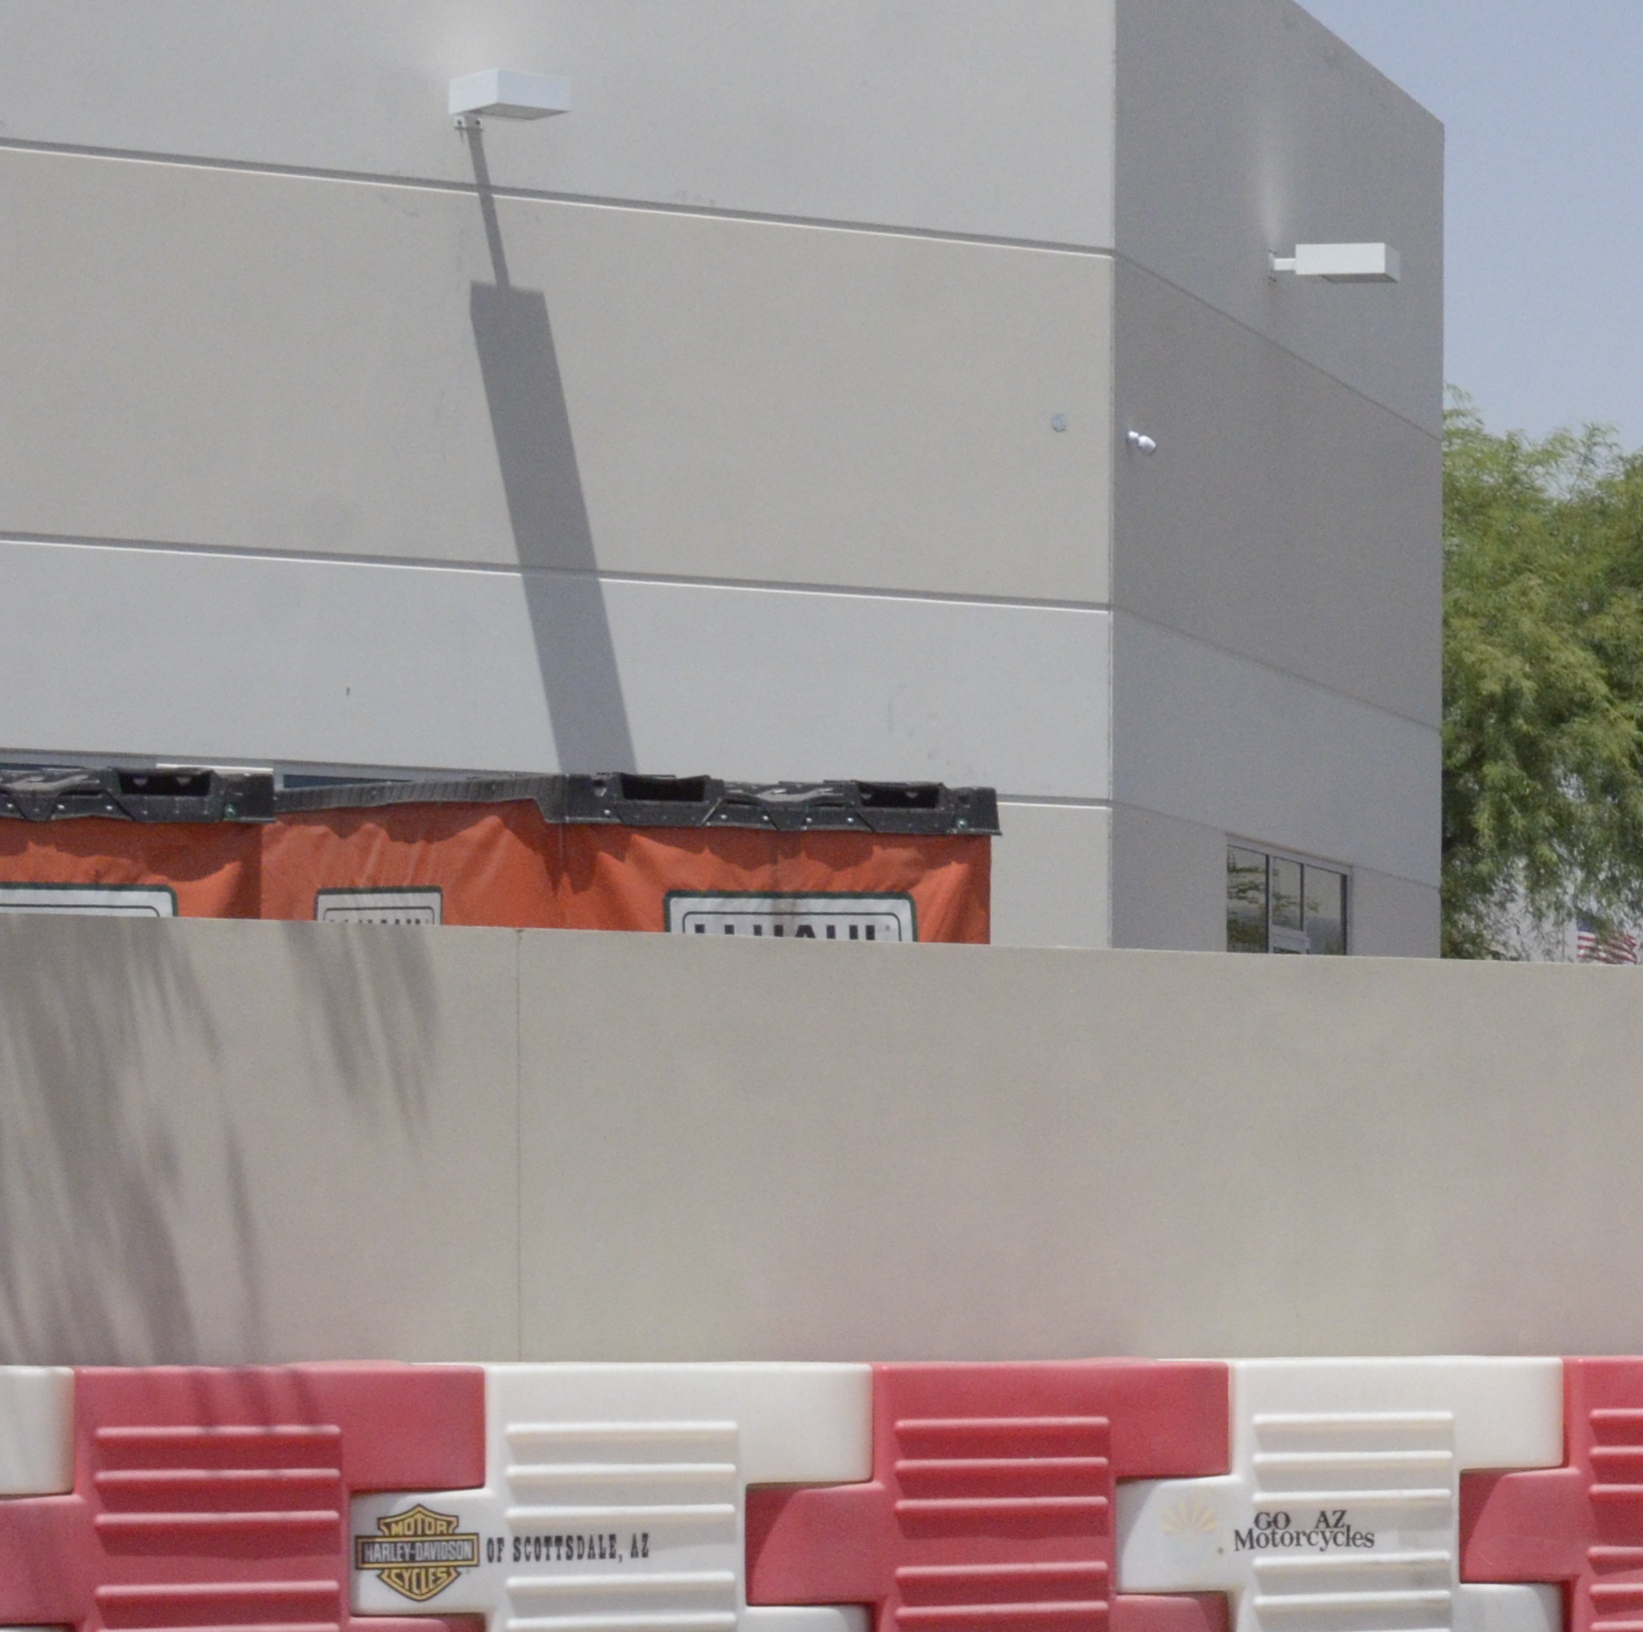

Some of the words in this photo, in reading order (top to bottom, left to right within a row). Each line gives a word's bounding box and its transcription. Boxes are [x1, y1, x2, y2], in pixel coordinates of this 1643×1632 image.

[391, 1513, 447, 1536] MOTOR
[1254, 1511, 1291, 1530] GO
[1315, 1510, 1347, 1529] AZ
[486, 1537, 504, 1563] OF
[513, 1534, 622, 1563] SCOTTSDALE,
[630, 1532, 649, 1558] AZ
[1234, 1525, 1375, 1551] Motorcycles
[363, 1540, 473, 1563] HARLEY-DAVIDSON
[390, 1567, 448, 1594] CYCLES
